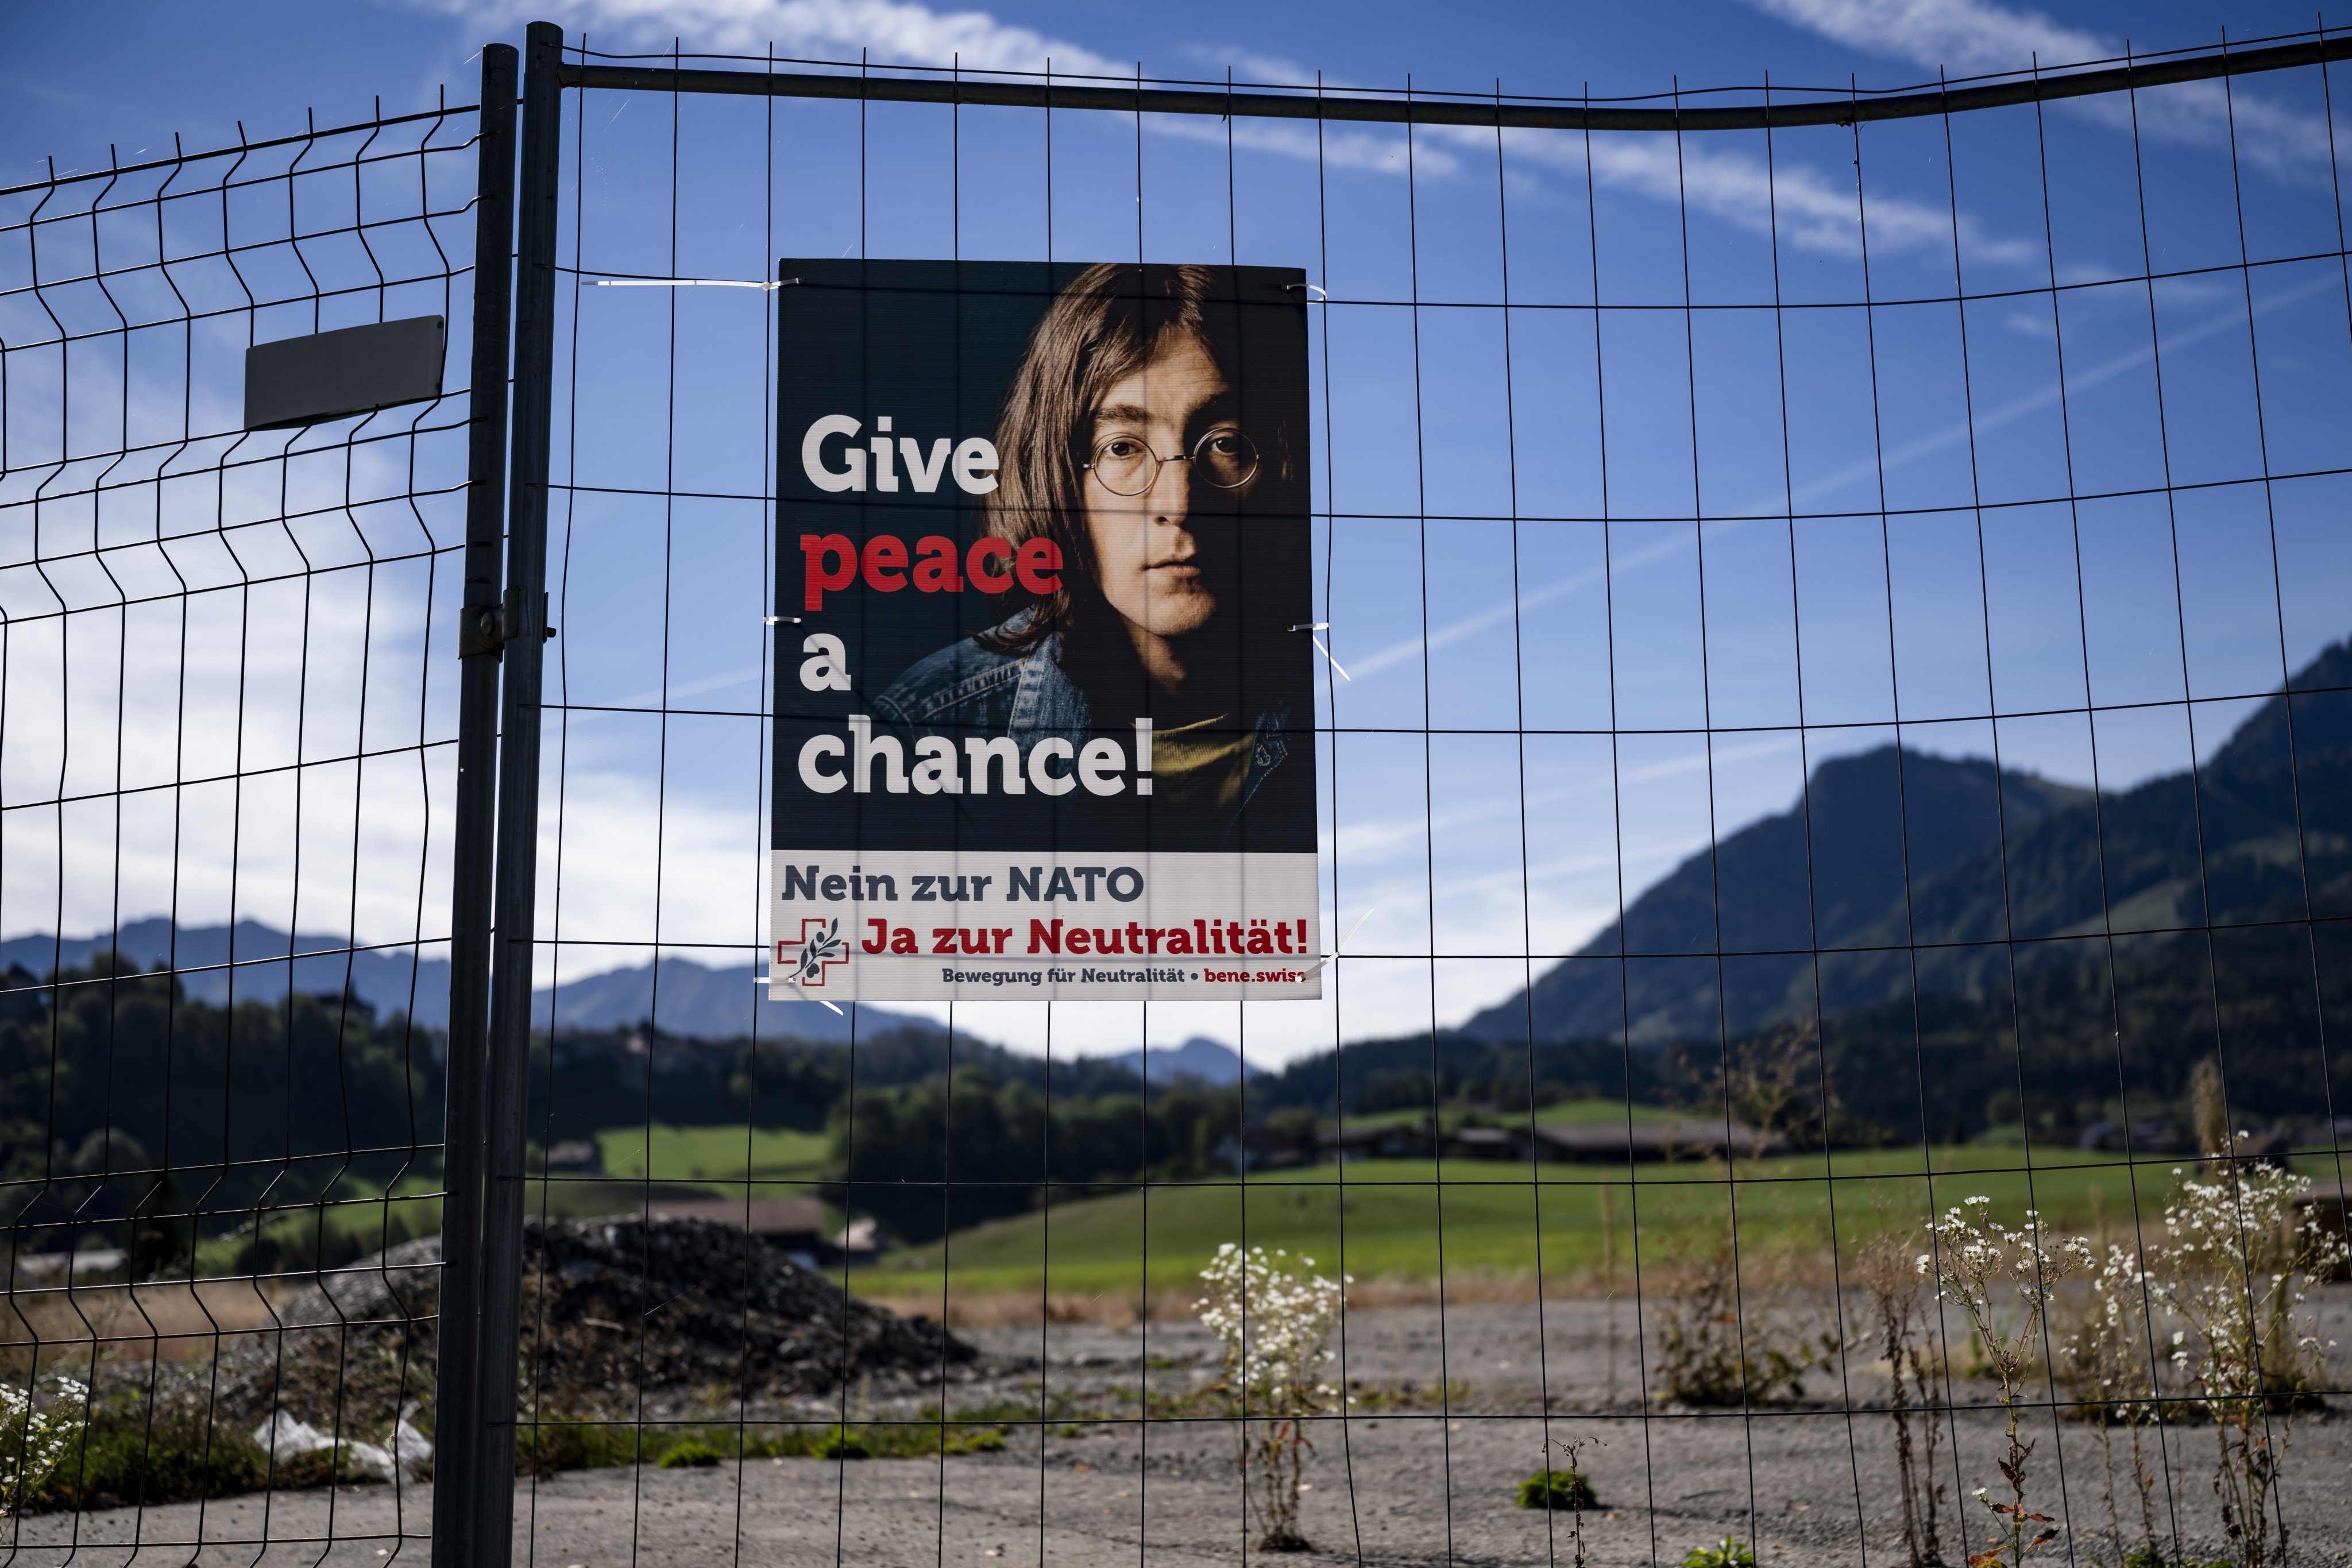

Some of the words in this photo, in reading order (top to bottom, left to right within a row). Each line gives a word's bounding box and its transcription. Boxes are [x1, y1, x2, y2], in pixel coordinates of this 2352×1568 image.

[801, 414, 1000, 494] Give
[800, 533, 1064, 612] peace
[799, 632, 852, 692] a
[797, 713, 1153, 797] chance!
[782, 864, 898, 901] Nein
[912, 875, 992, 902] zur
[1006, 866, 1145, 902] NATO
[862, 918, 919, 955] Ja
[932, 928, 1013, 955] zur
[1027, 918, 1307, 955] Neutralität!
[941, 968, 1042, 986] Bewegung
[1047, 968, 1076, 983] für
[1080, 968, 1185, 983] Neutralität
